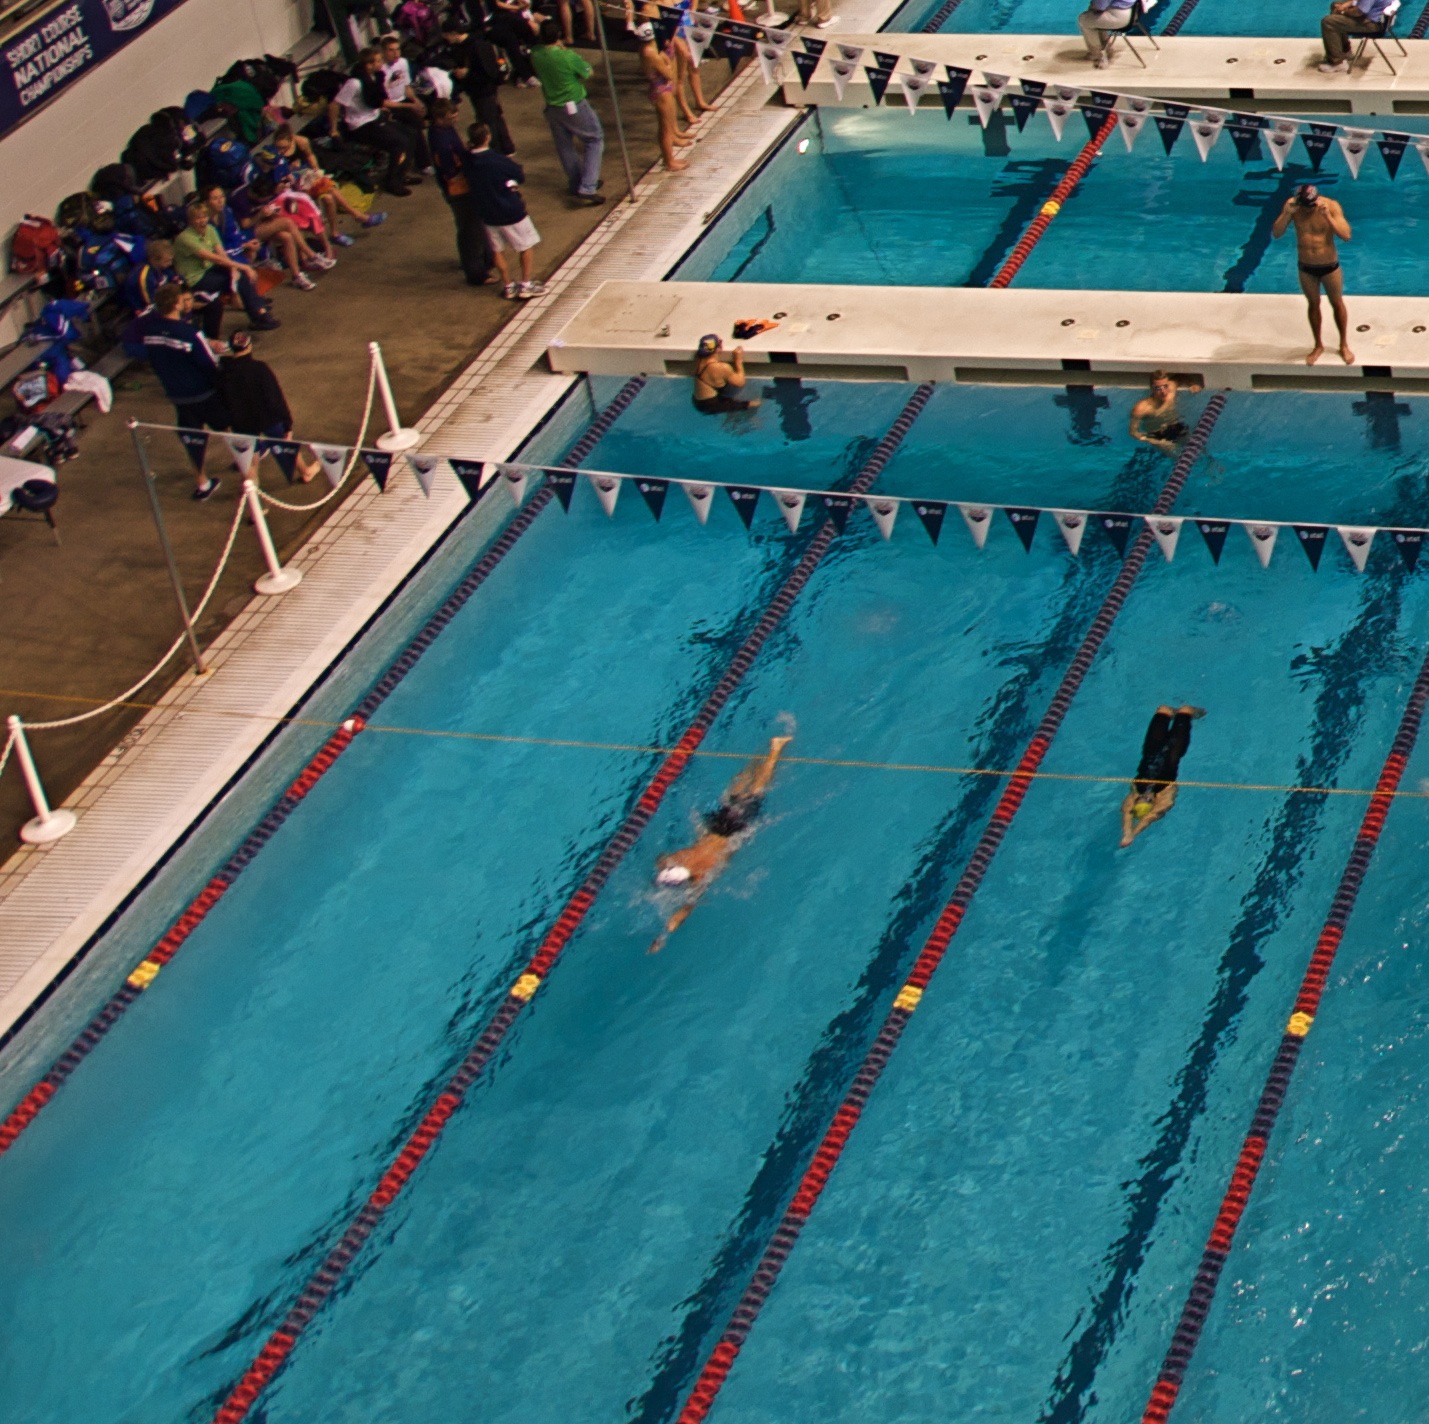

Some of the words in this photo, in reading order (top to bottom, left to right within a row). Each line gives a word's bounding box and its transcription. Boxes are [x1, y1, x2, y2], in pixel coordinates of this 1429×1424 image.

[6, 34, 42, 68] SHORT
[41, 5, 84, 44] COURSE
[14, 27, 90, 89] NATIONAL
[19, 43, 94, 107] CHAMPIONSHIPS
